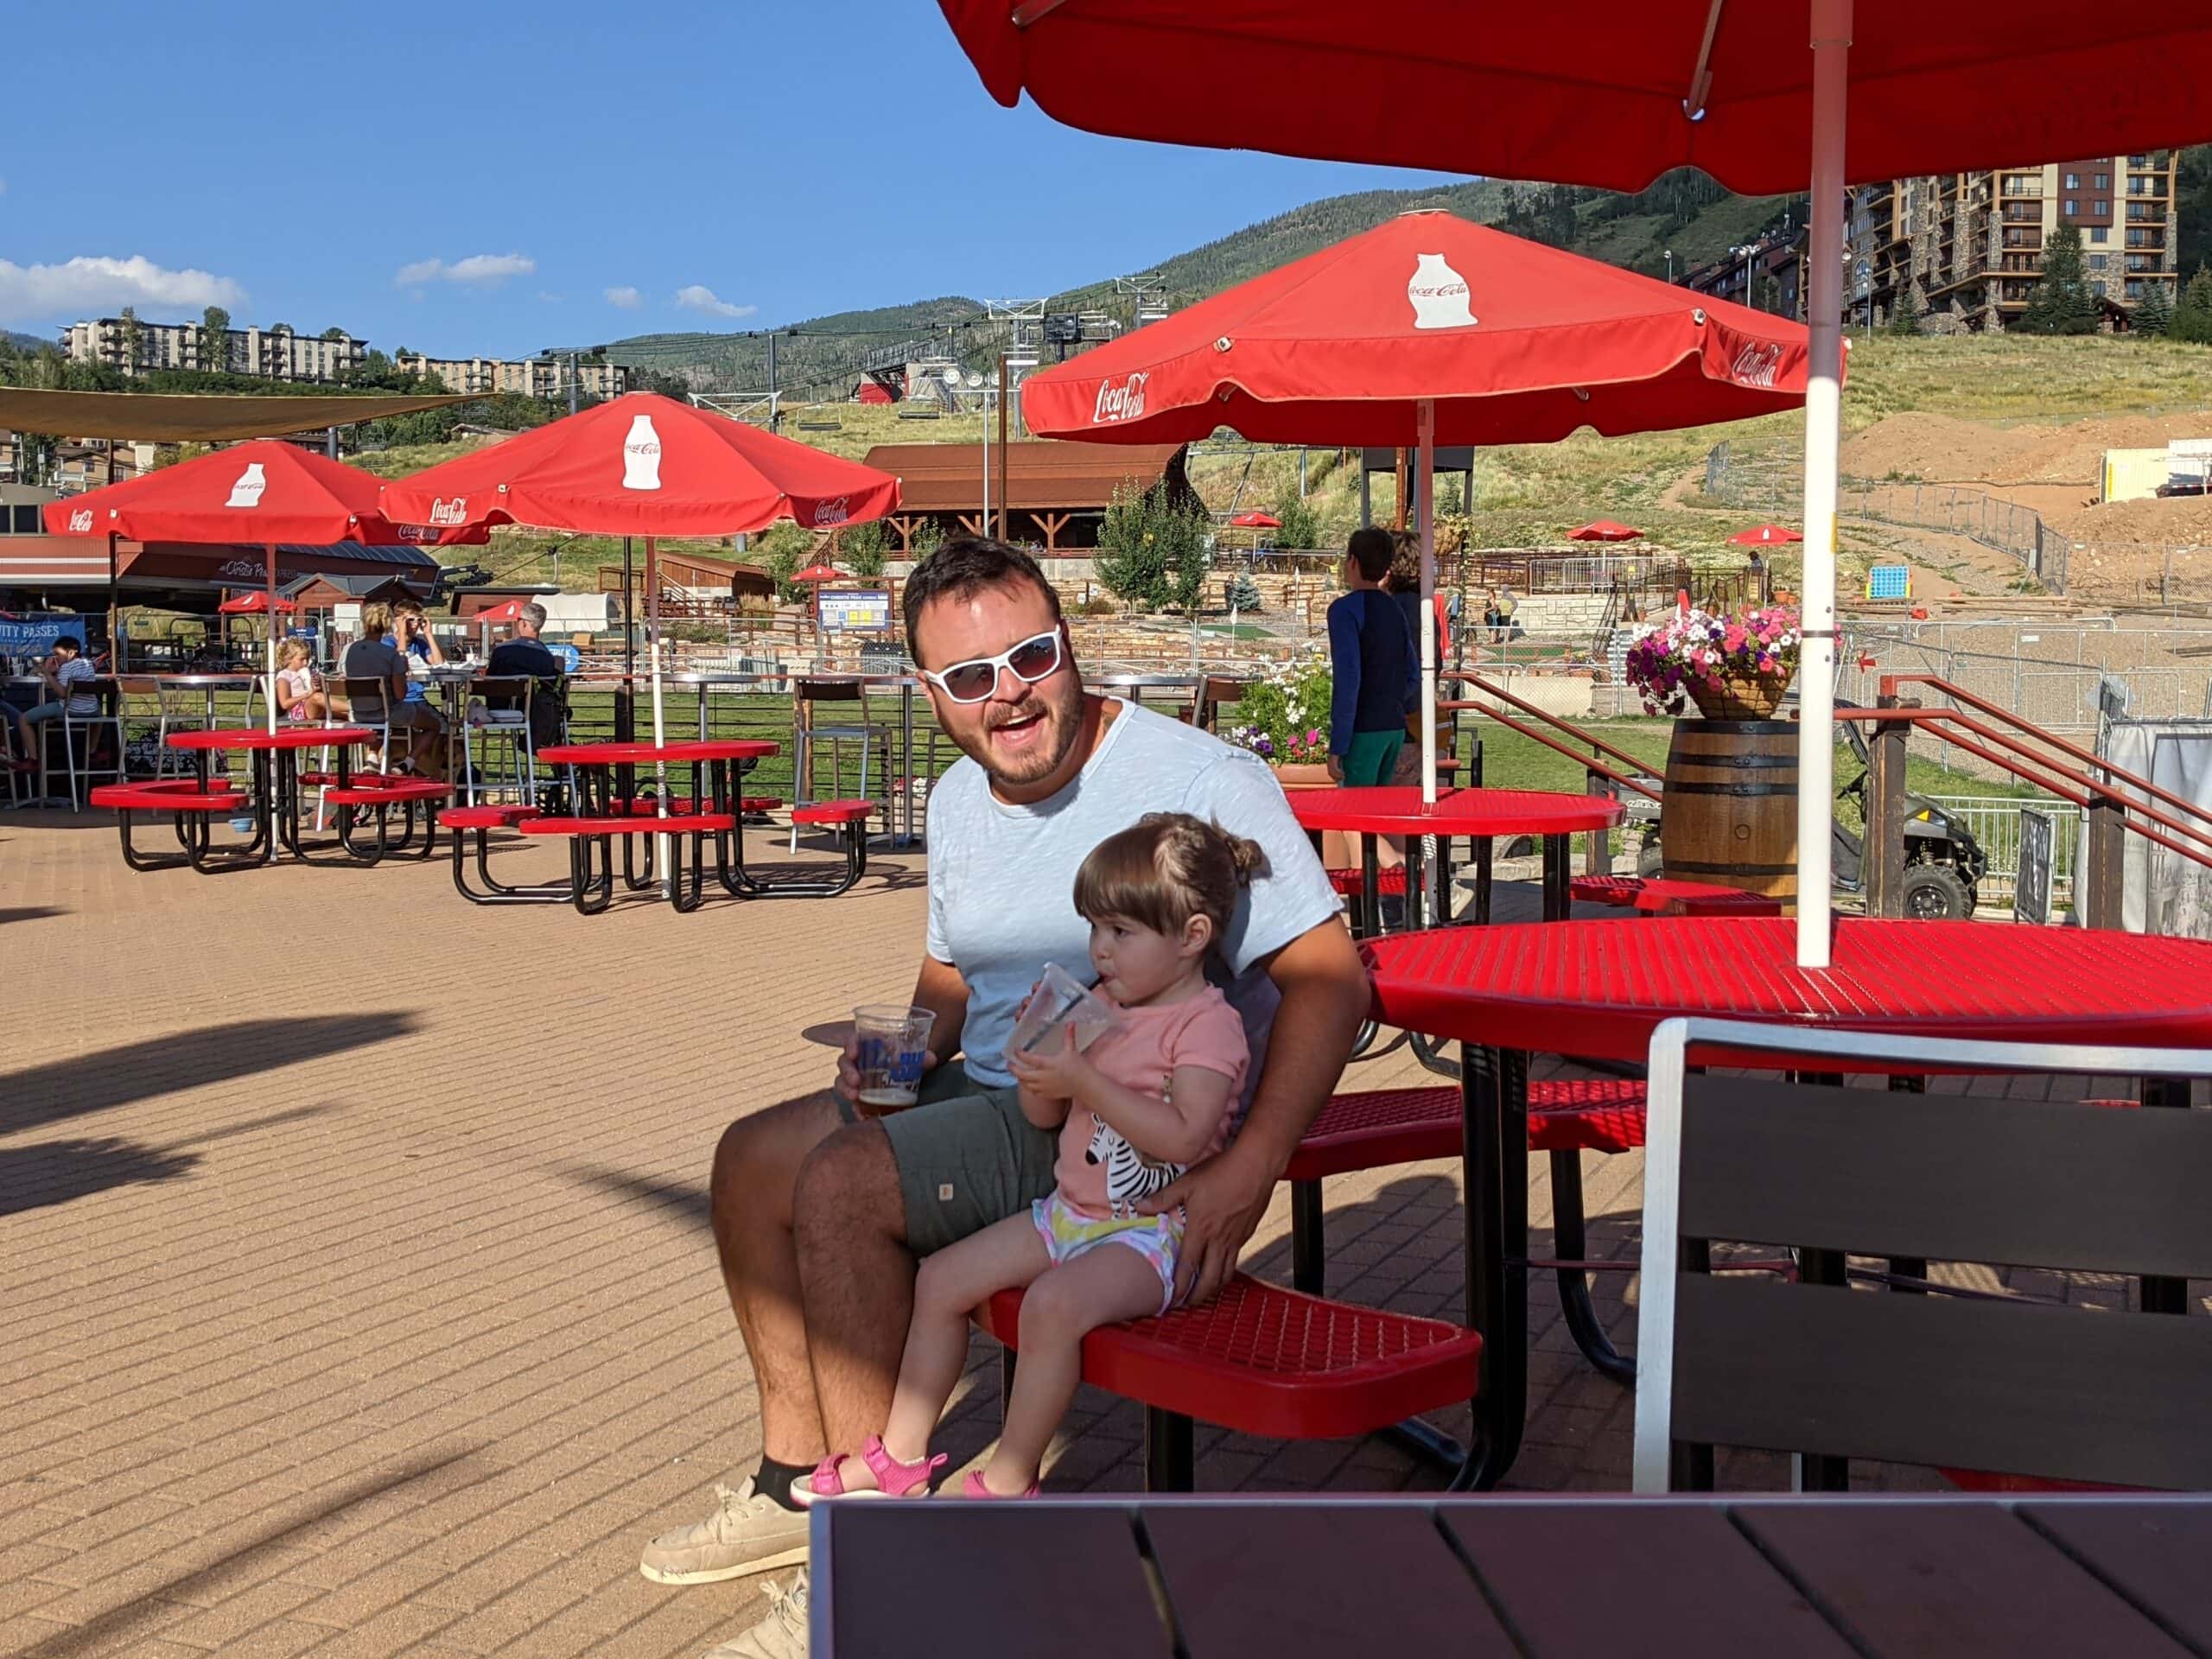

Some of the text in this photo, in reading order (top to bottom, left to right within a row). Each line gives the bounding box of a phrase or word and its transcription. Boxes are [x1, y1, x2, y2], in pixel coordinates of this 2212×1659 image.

[1093, 372, 1150, 423] Coca-Cola
[429, 498, 467, 524] Coca-Cola
[0, 625, 60, 638] ITY PASSES
